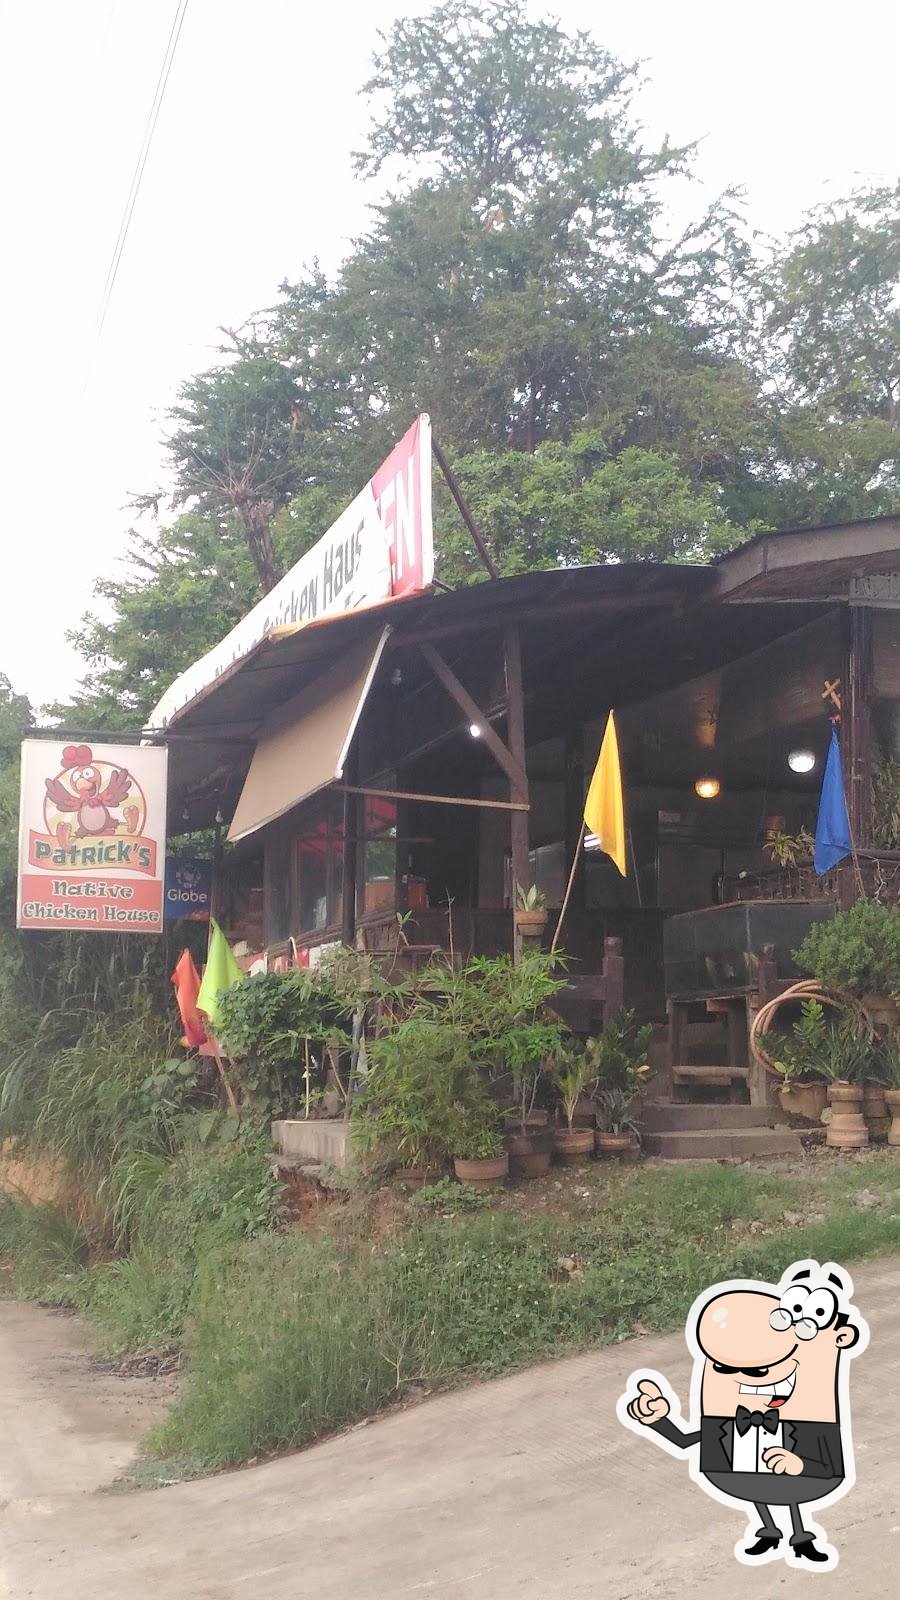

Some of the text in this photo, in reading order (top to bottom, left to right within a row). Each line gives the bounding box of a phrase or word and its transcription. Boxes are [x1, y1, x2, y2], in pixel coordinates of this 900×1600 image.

[52, 880, 133, 899] Native
[167, 888, 208, 903] Globe
[23, 902, 160, 923] Chicken House
